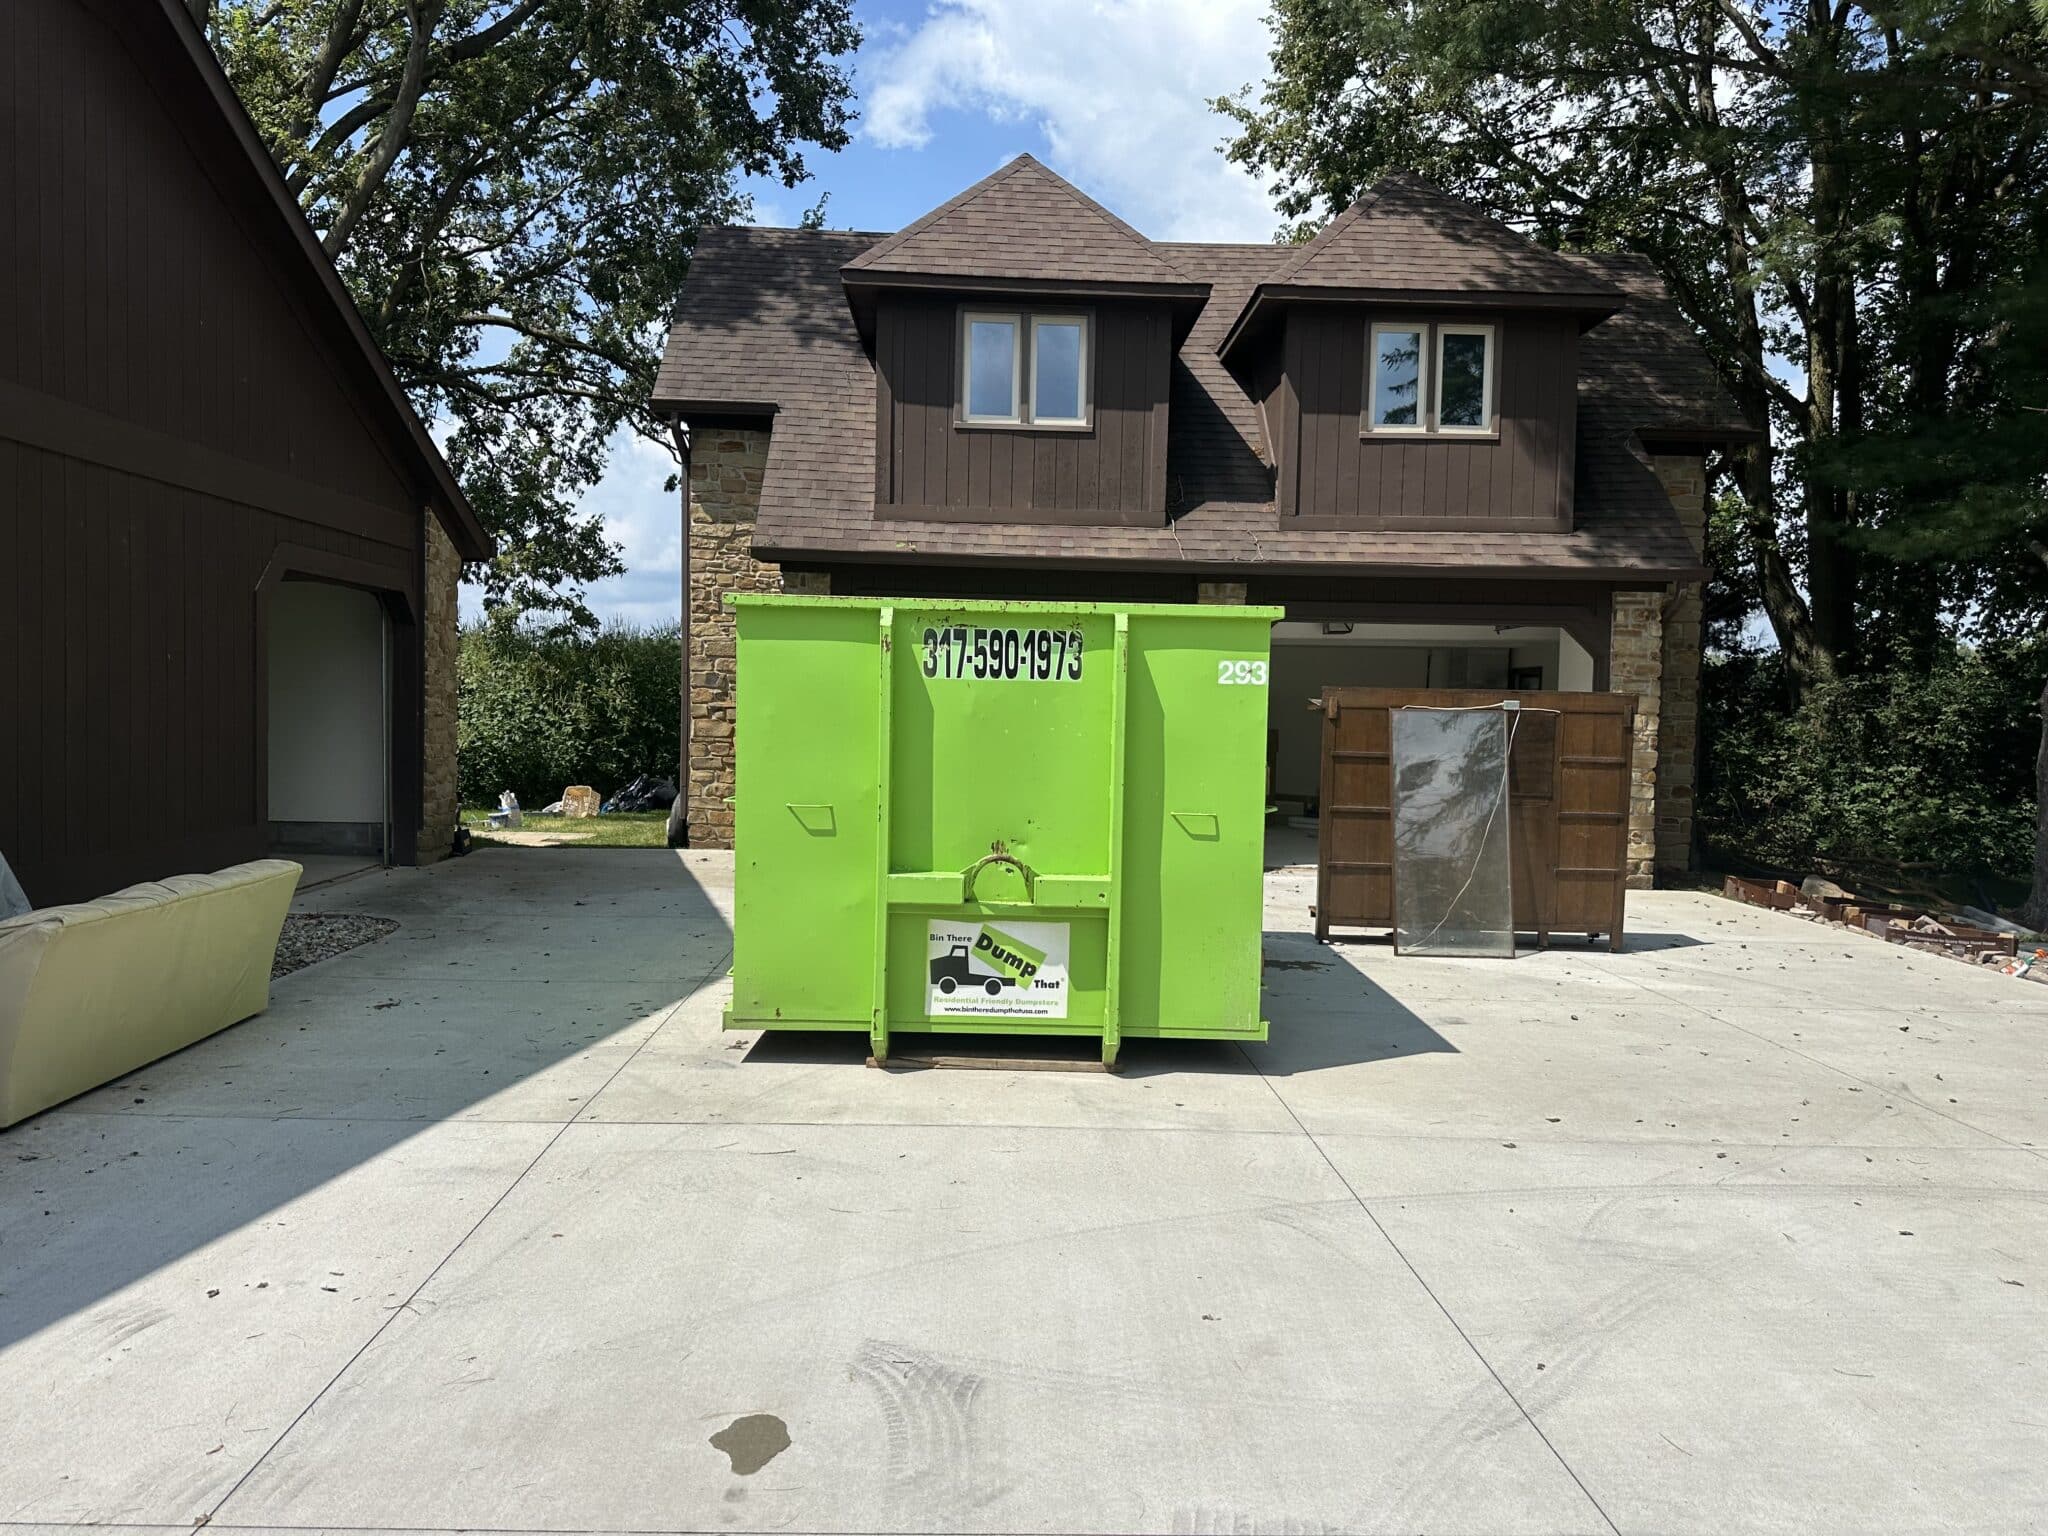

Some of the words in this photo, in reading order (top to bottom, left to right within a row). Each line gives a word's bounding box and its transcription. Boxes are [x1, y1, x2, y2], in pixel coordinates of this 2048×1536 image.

[923, 628, 1083, 680] 317-590-1973
[1218, 660, 1267, 685] 293
[930, 934, 944, 942] Bin
[947, 934, 972, 942] There
[975, 932, 1037, 977] Dump
[1034, 979, 1060, 989] That
[934, 996, 979, 1004] Residential
[981, 997, 1013, 1006] Friendly
[1016, 998, 1059, 1007] Dumpsters
[944, 1006, 1048, 1015] www.bintheredumpthatusa.com
